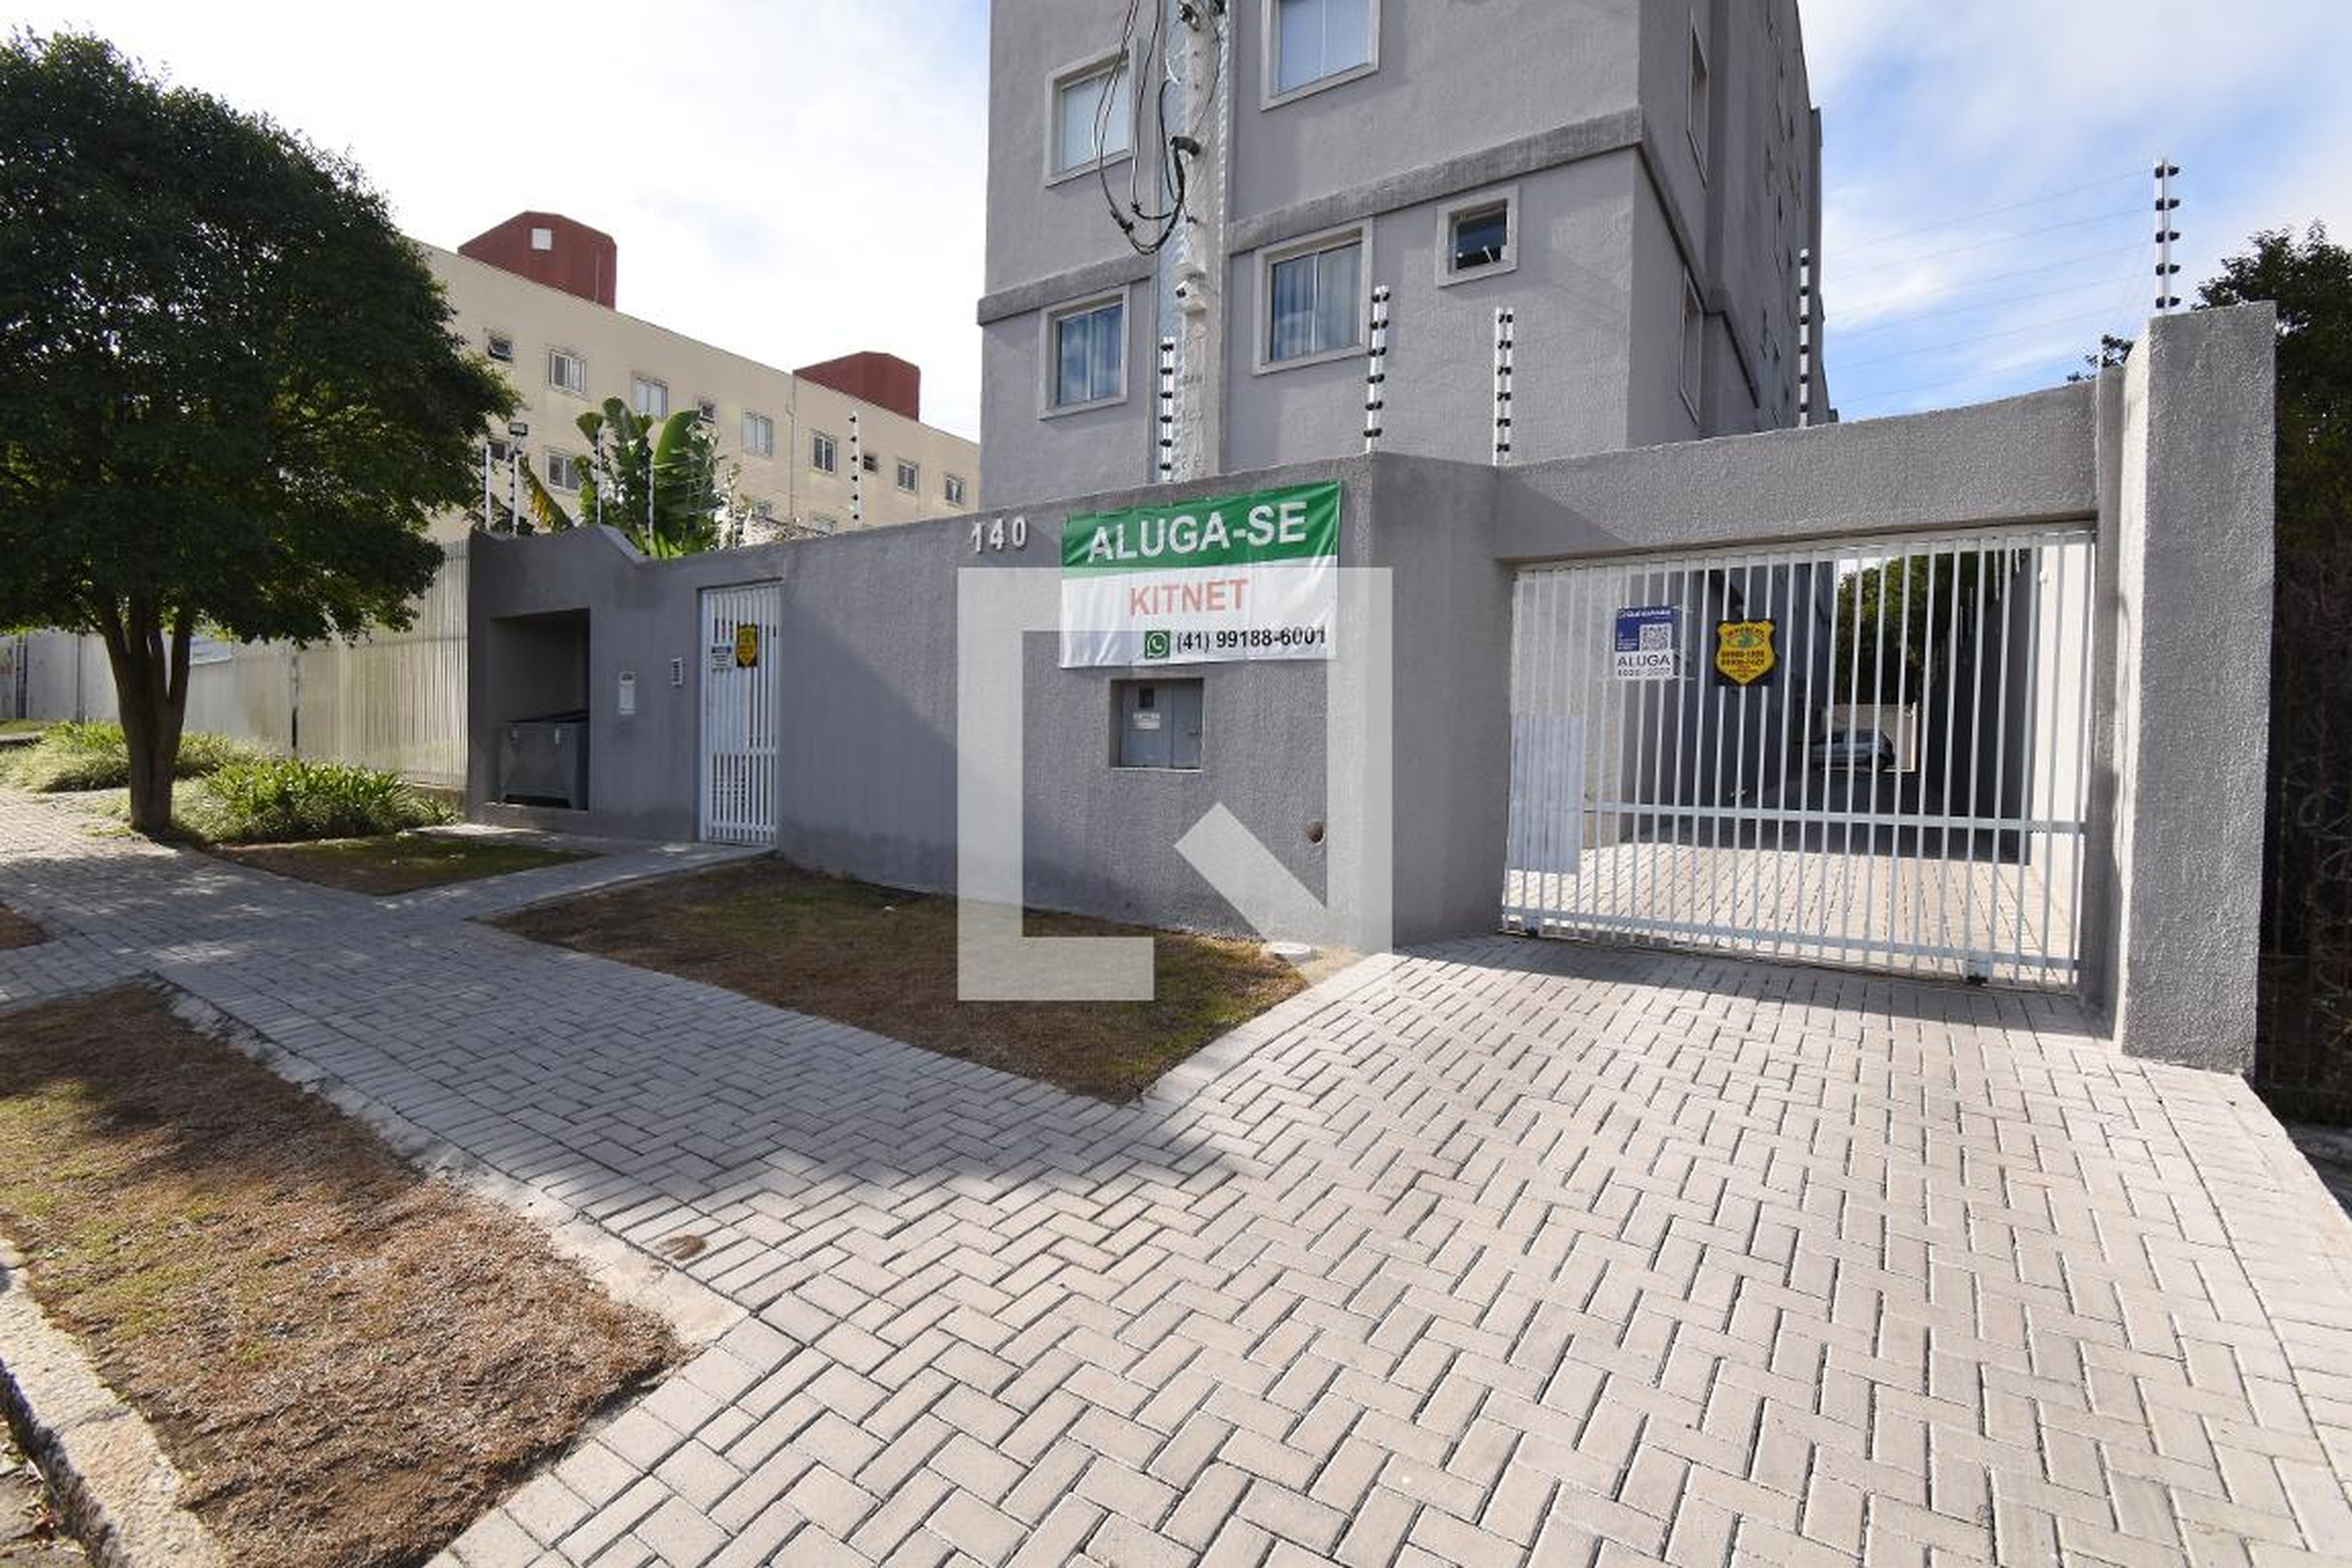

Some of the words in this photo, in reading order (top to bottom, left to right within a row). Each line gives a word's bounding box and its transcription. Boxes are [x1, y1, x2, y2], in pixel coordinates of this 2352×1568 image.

[970, 516, 1027, 552] 140
[1087, 501, 1308, 563] ALUGA-SE
[1129, 578, 1248, 616] KITNET
[1177, 632, 1210, 654] (41)
[1216, 625, 1325, 648] 99188-6001
[1618, 654, 1670, 667] ALUGA
